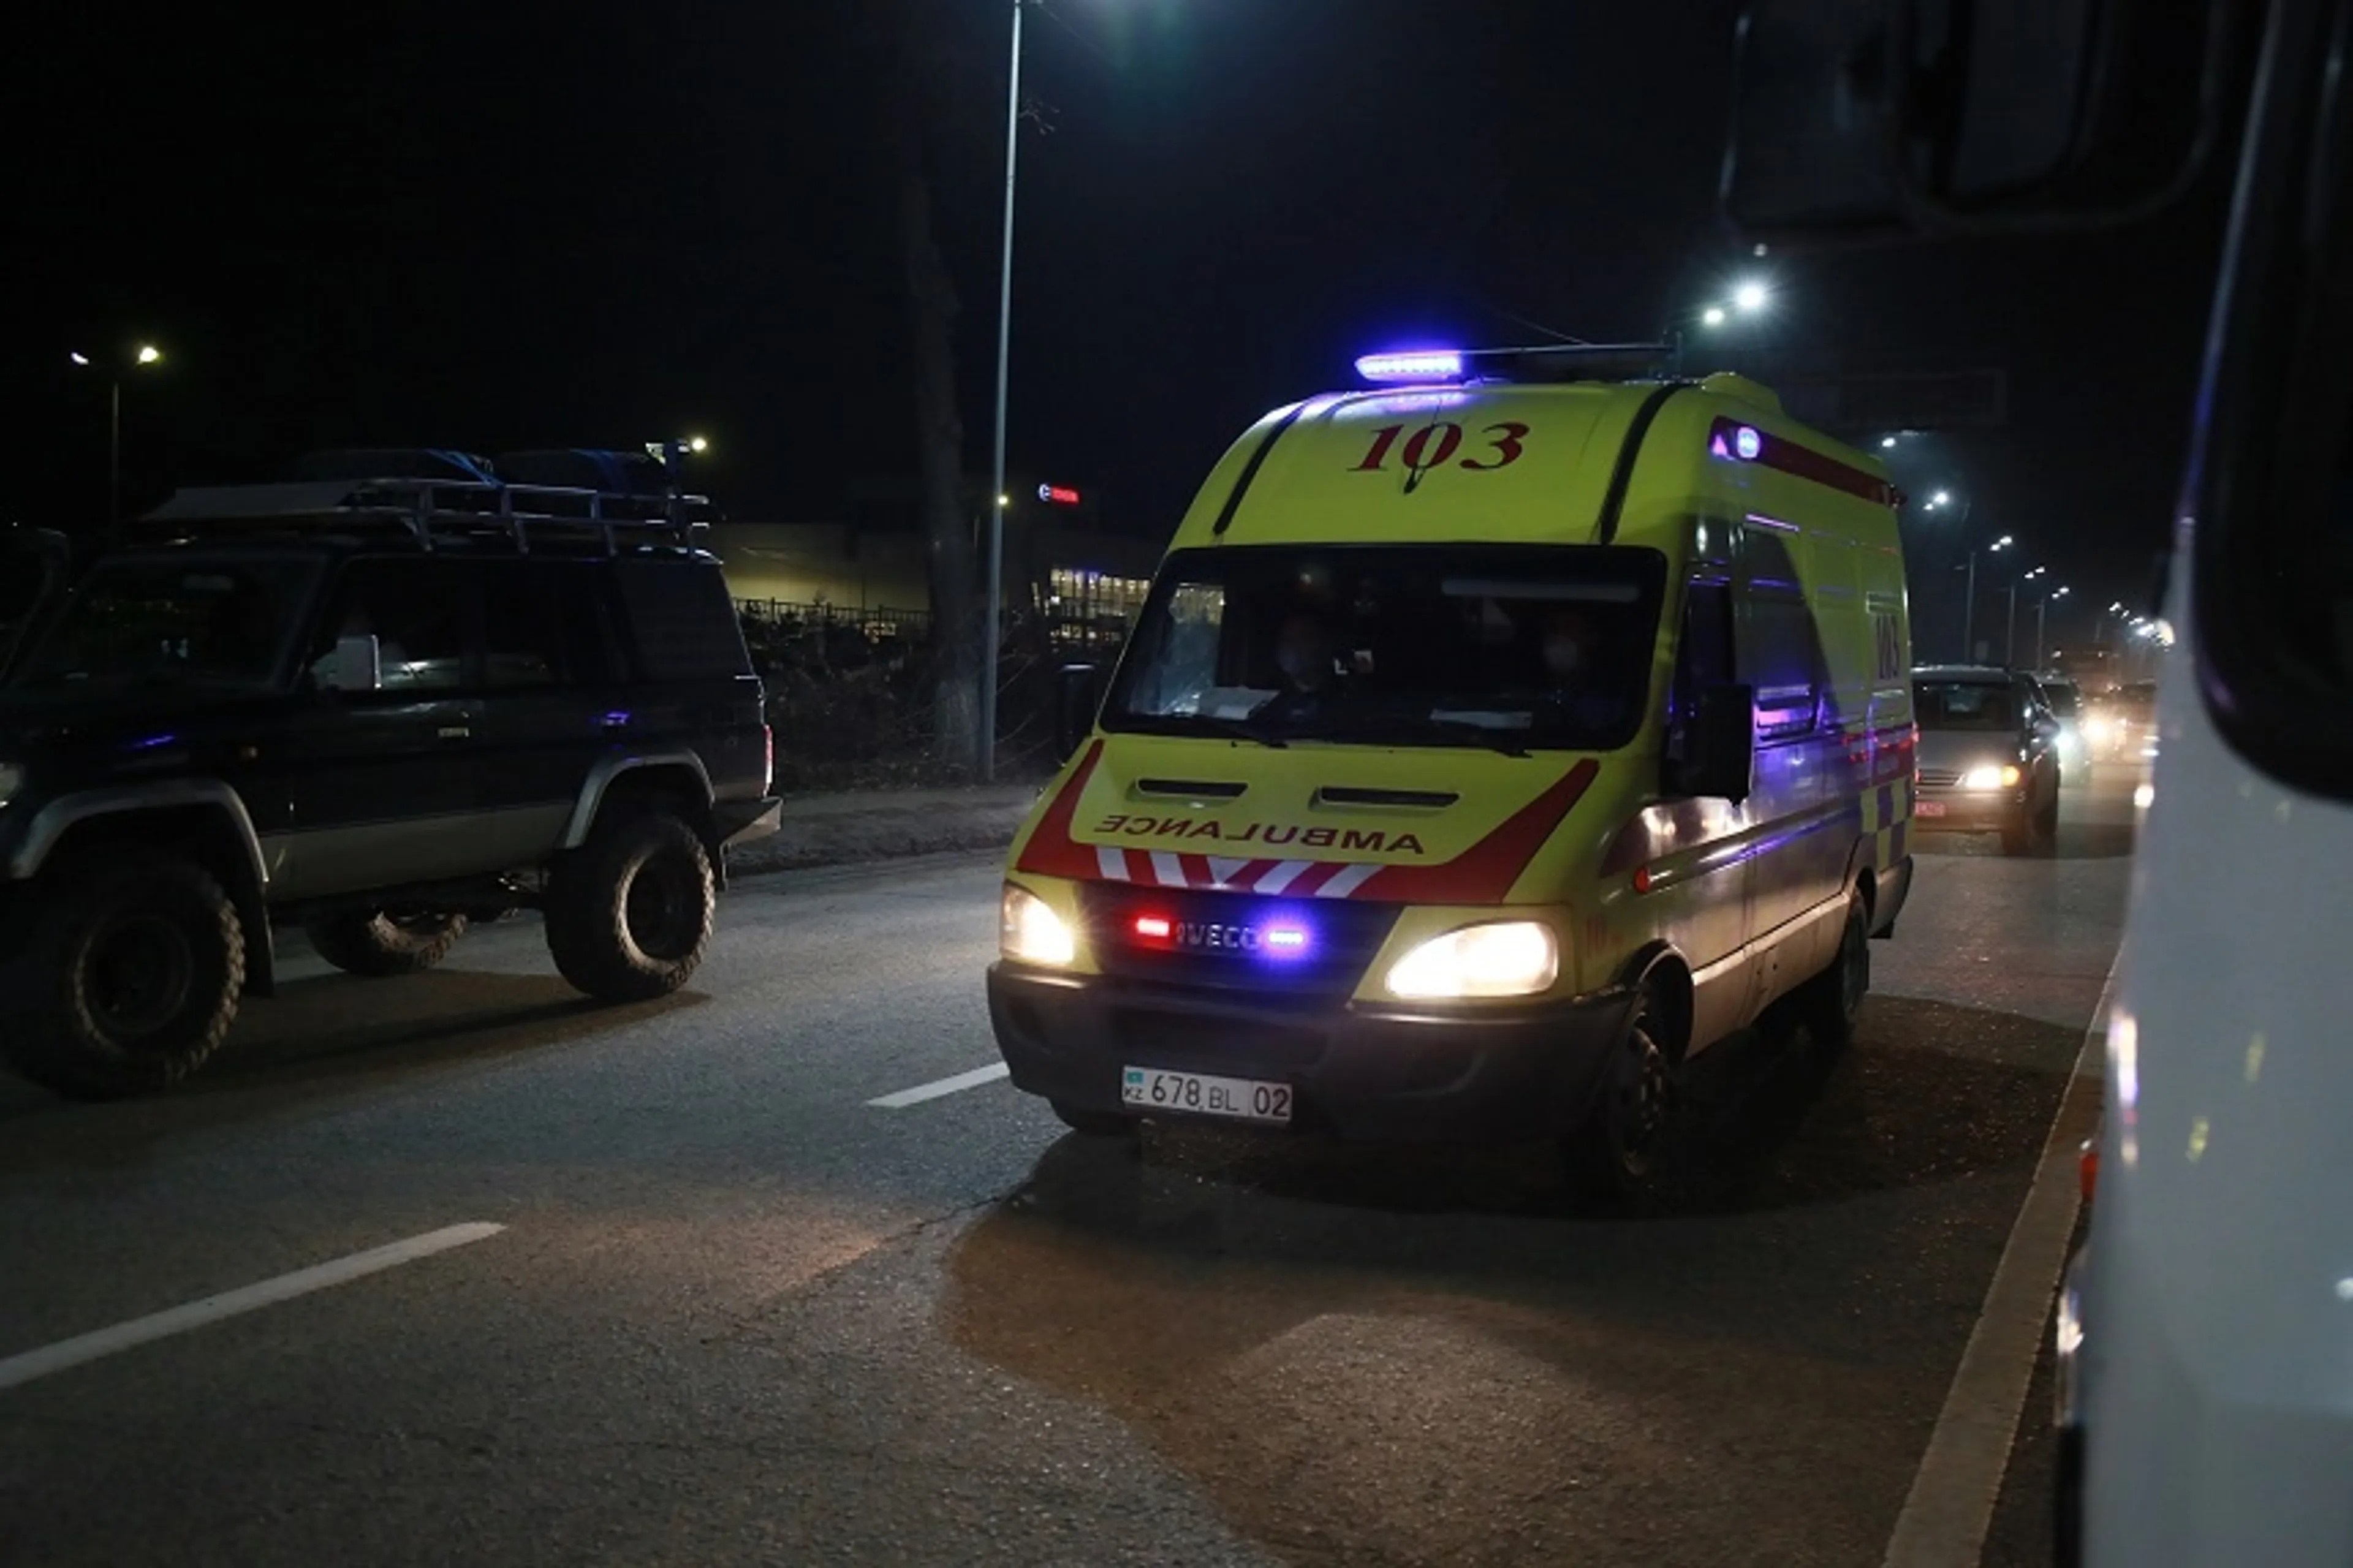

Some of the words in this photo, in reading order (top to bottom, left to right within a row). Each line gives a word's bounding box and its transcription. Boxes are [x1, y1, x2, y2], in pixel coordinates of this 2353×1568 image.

[1347, 423, 1530, 471] 103
[1176, 922, 1259, 950] IVECO
[1151, 1074, 1202, 1106] 678
[1209, 1086, 1239, 1112] BL
[1253, 1086, 1290, 1116] 02
